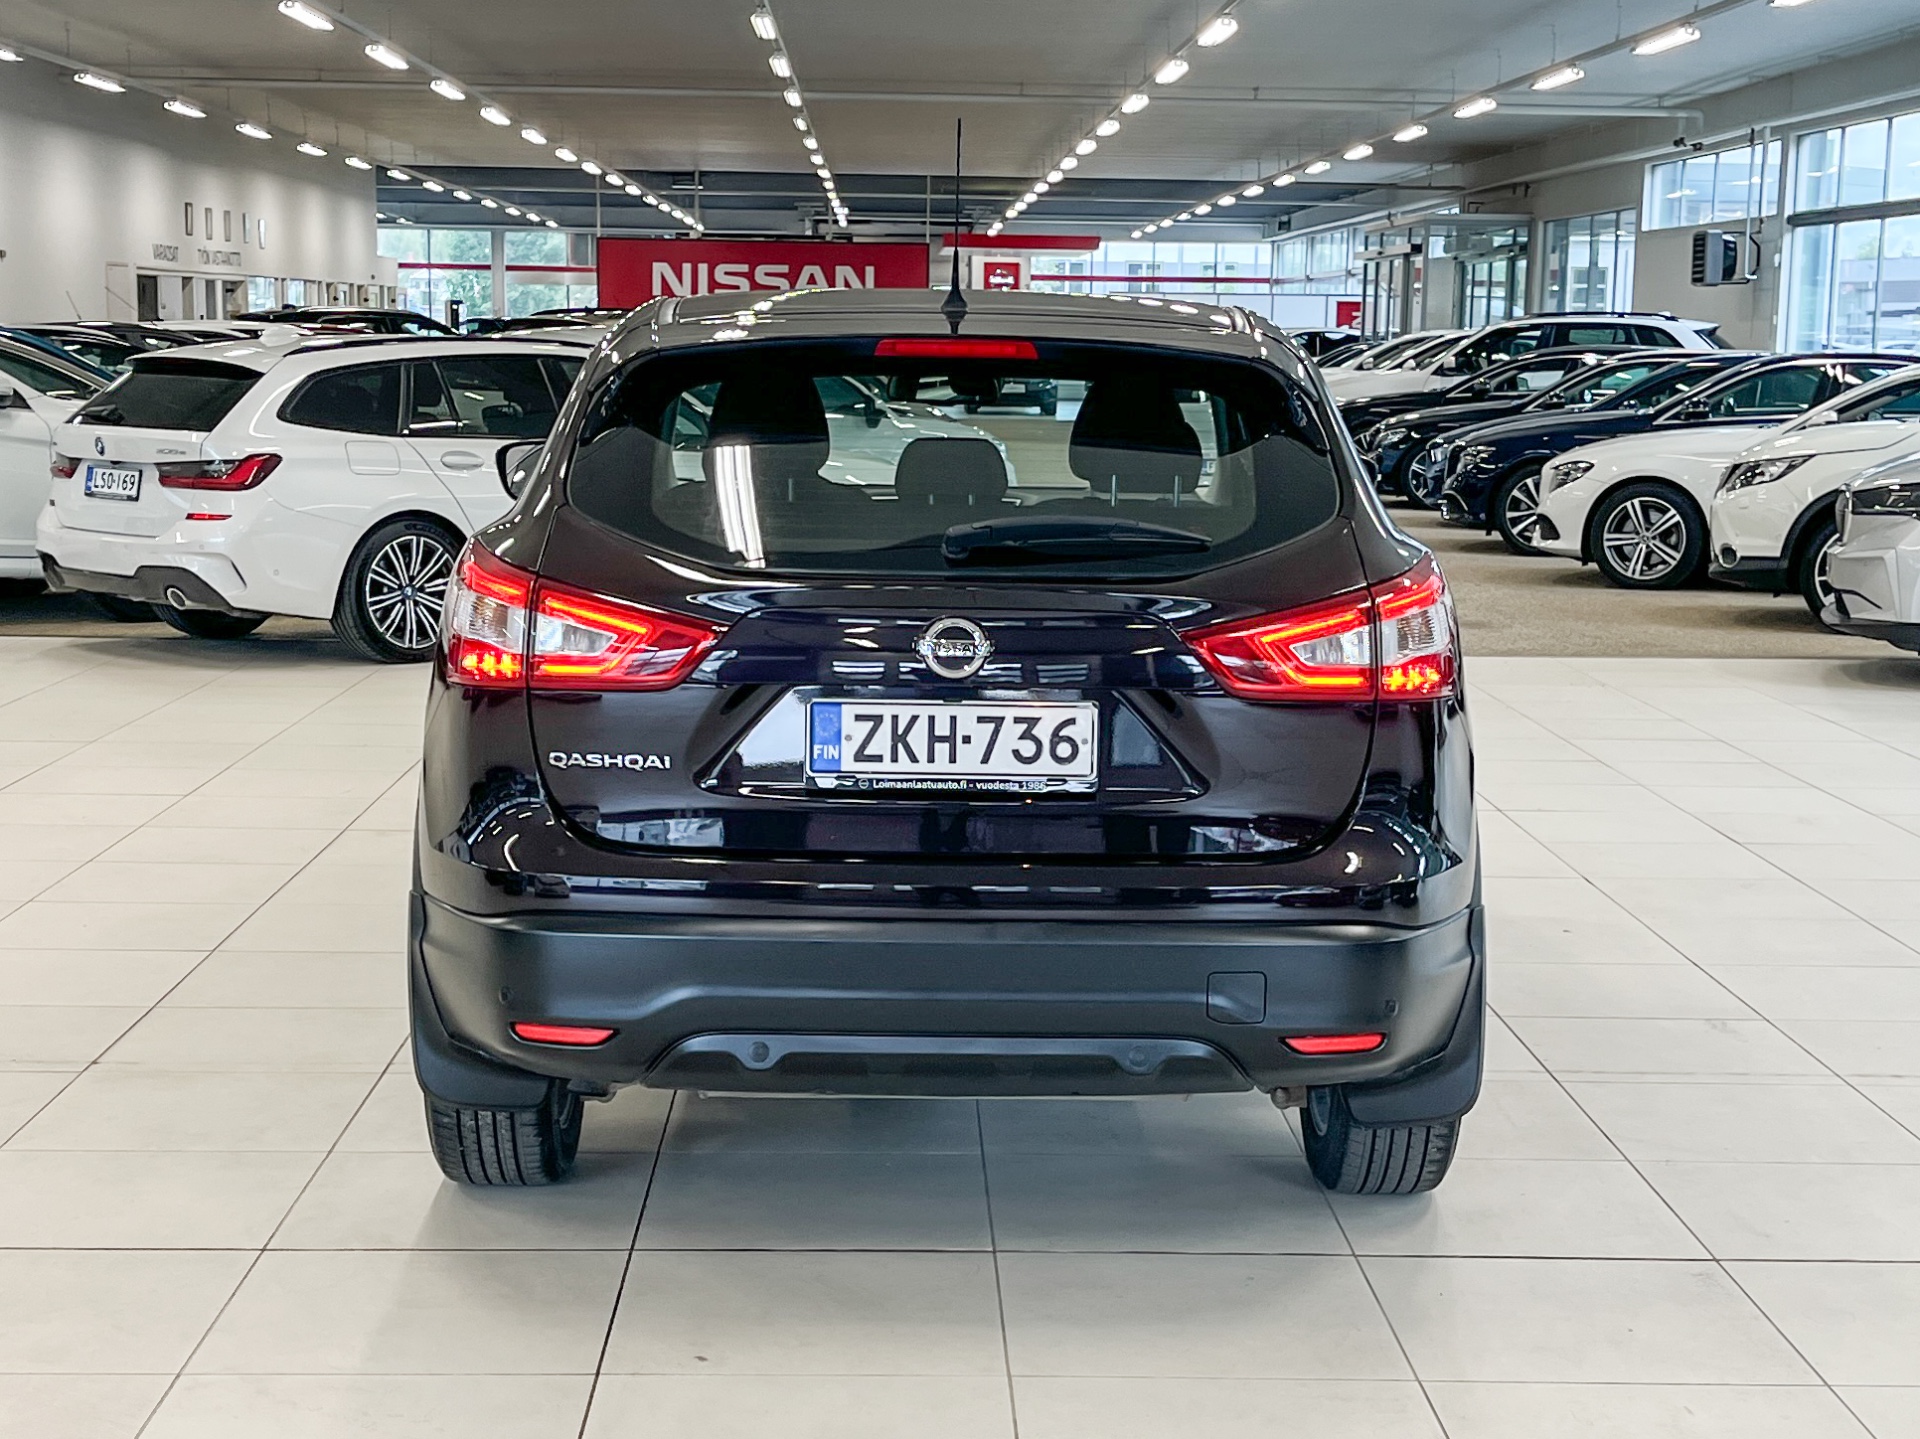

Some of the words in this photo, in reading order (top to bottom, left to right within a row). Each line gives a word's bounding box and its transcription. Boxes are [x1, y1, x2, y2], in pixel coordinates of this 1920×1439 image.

[651, 261, 876, 297] NISSAN
[94, 470, 136, 492] LSO-169
[852, 713, 1081, 766] ZKH-736
[548, 751, 672, 771] QASHQAI
[812, 744, 840, 761] FIN
[872, 778, 968, 790] Loimaanlaatuauto.fi
[975, 780, 1020, 791] vuodesta
